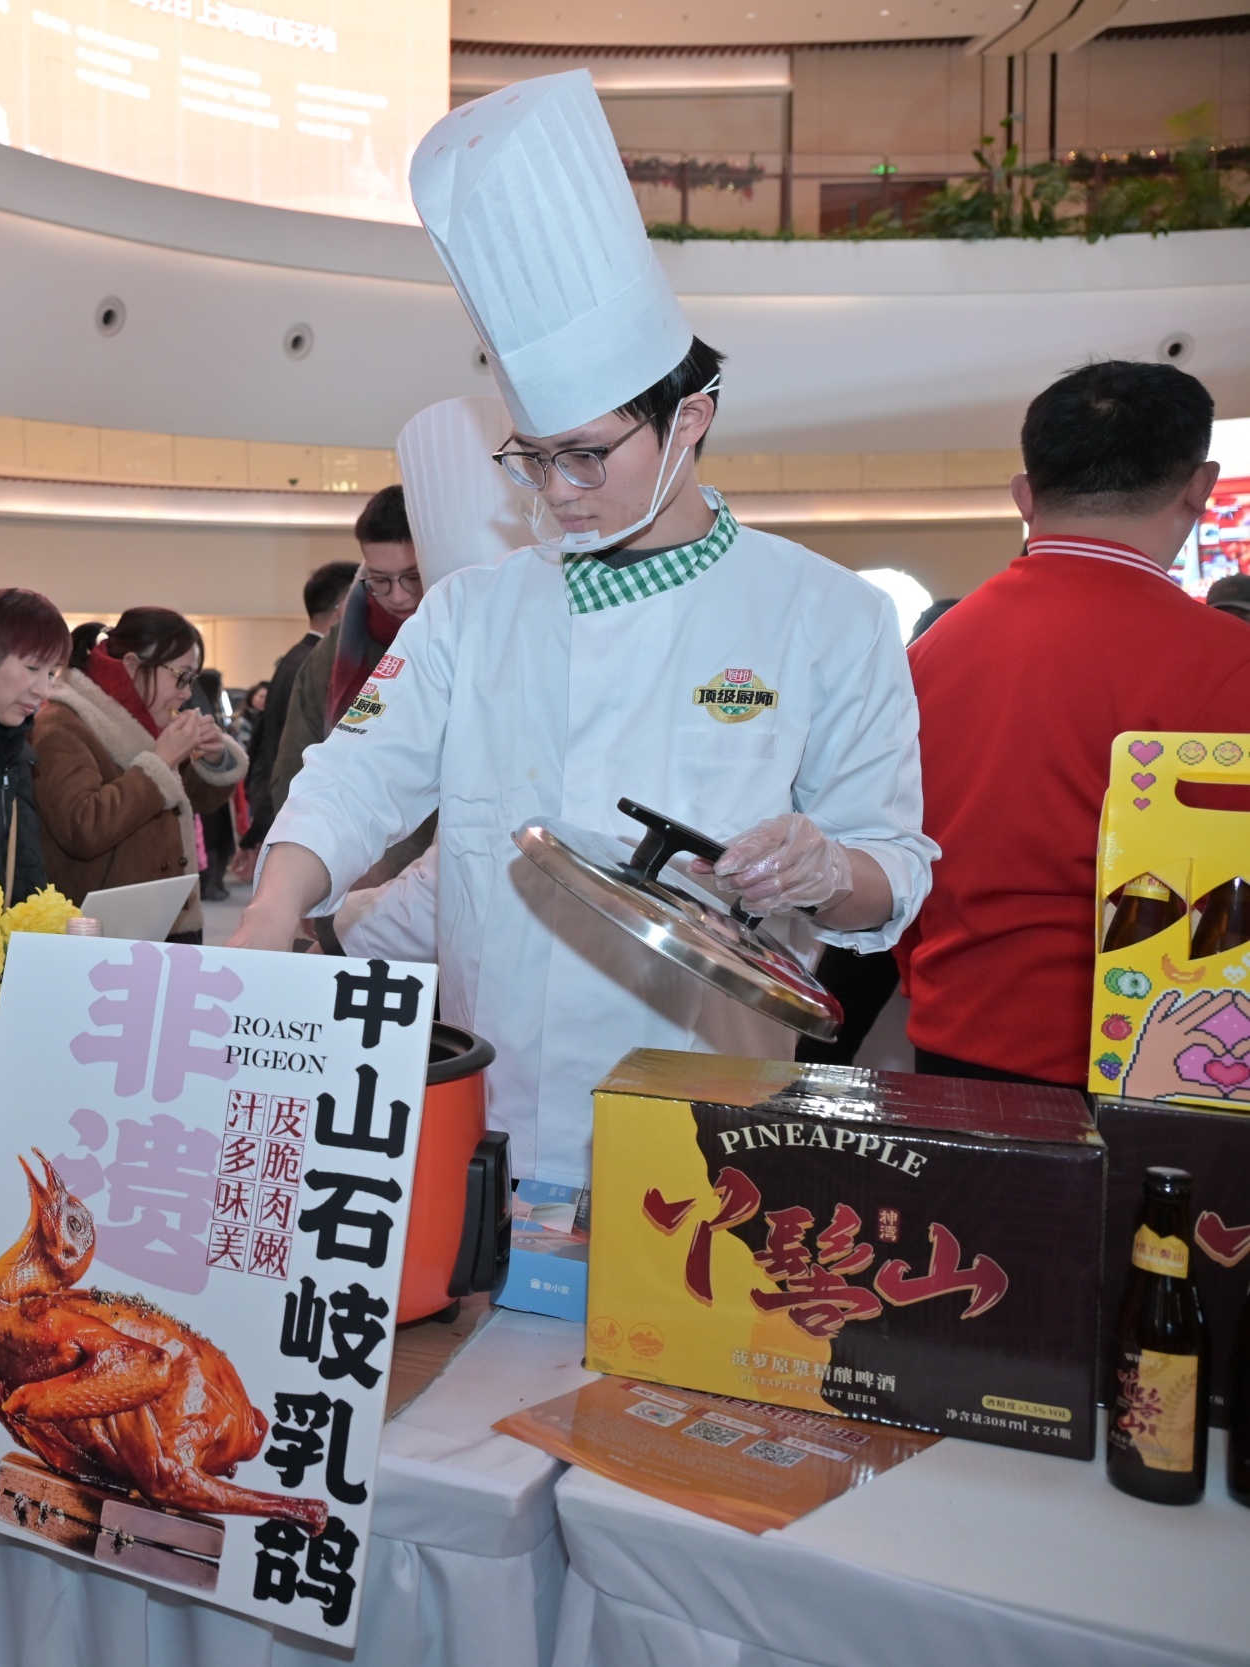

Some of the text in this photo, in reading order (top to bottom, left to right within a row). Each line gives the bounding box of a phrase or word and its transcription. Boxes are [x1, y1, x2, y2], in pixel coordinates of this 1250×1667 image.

[698, 689, 774, 707] 顶级厨师
[231, 1014, 323, 1043] ROAST
[223, 1045, 328, 1075] PIGEON
[44, 940, 244, 1296] 非遗
[717, 1123, 928, 1178] PINEAPPLE
[207, 1092, 264, 1269] 汁多味美
[248, 1096, 308, 1279] 皮脆肉嫩
[879, 1210, 898, 1242] 神湾
[252, 959, 424, 1627] 中山石岐乳鸽
[739, 1374, 877, 1405] PINEAPPLE CRAFT BEER
[1048, 1409, 1069, 1419] VOL
[1042, 1425, 1072, 1440] 24瓶
